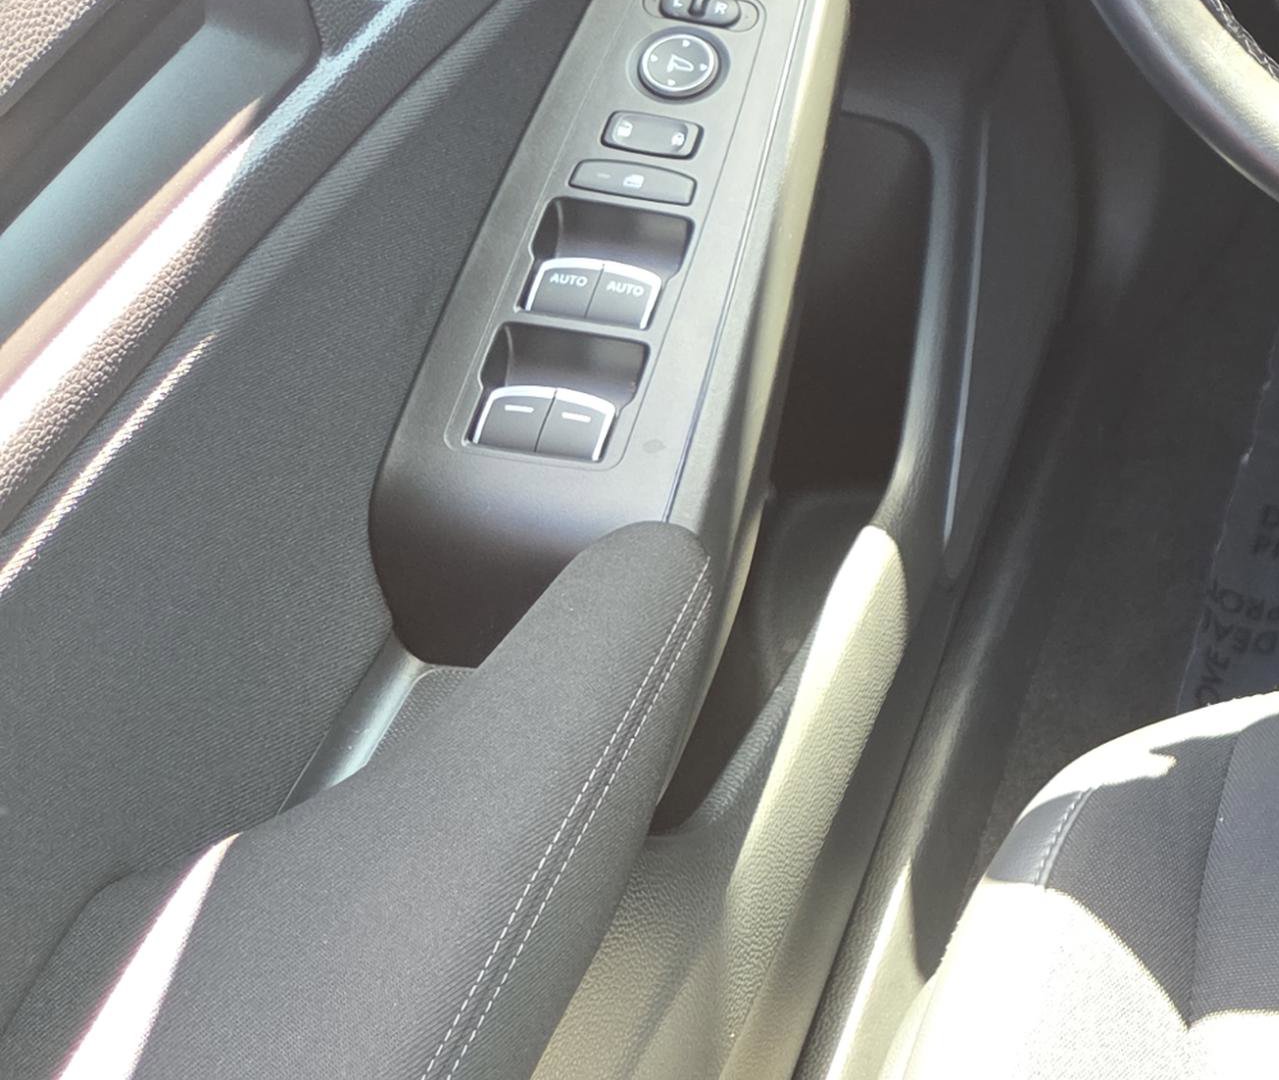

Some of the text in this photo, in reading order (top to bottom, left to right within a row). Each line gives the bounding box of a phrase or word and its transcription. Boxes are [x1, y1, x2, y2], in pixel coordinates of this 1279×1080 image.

[714, 1, 729, 15] R
[549, 271, 588, 287] AUTO
[606, 278, 646, 297] AUTO
